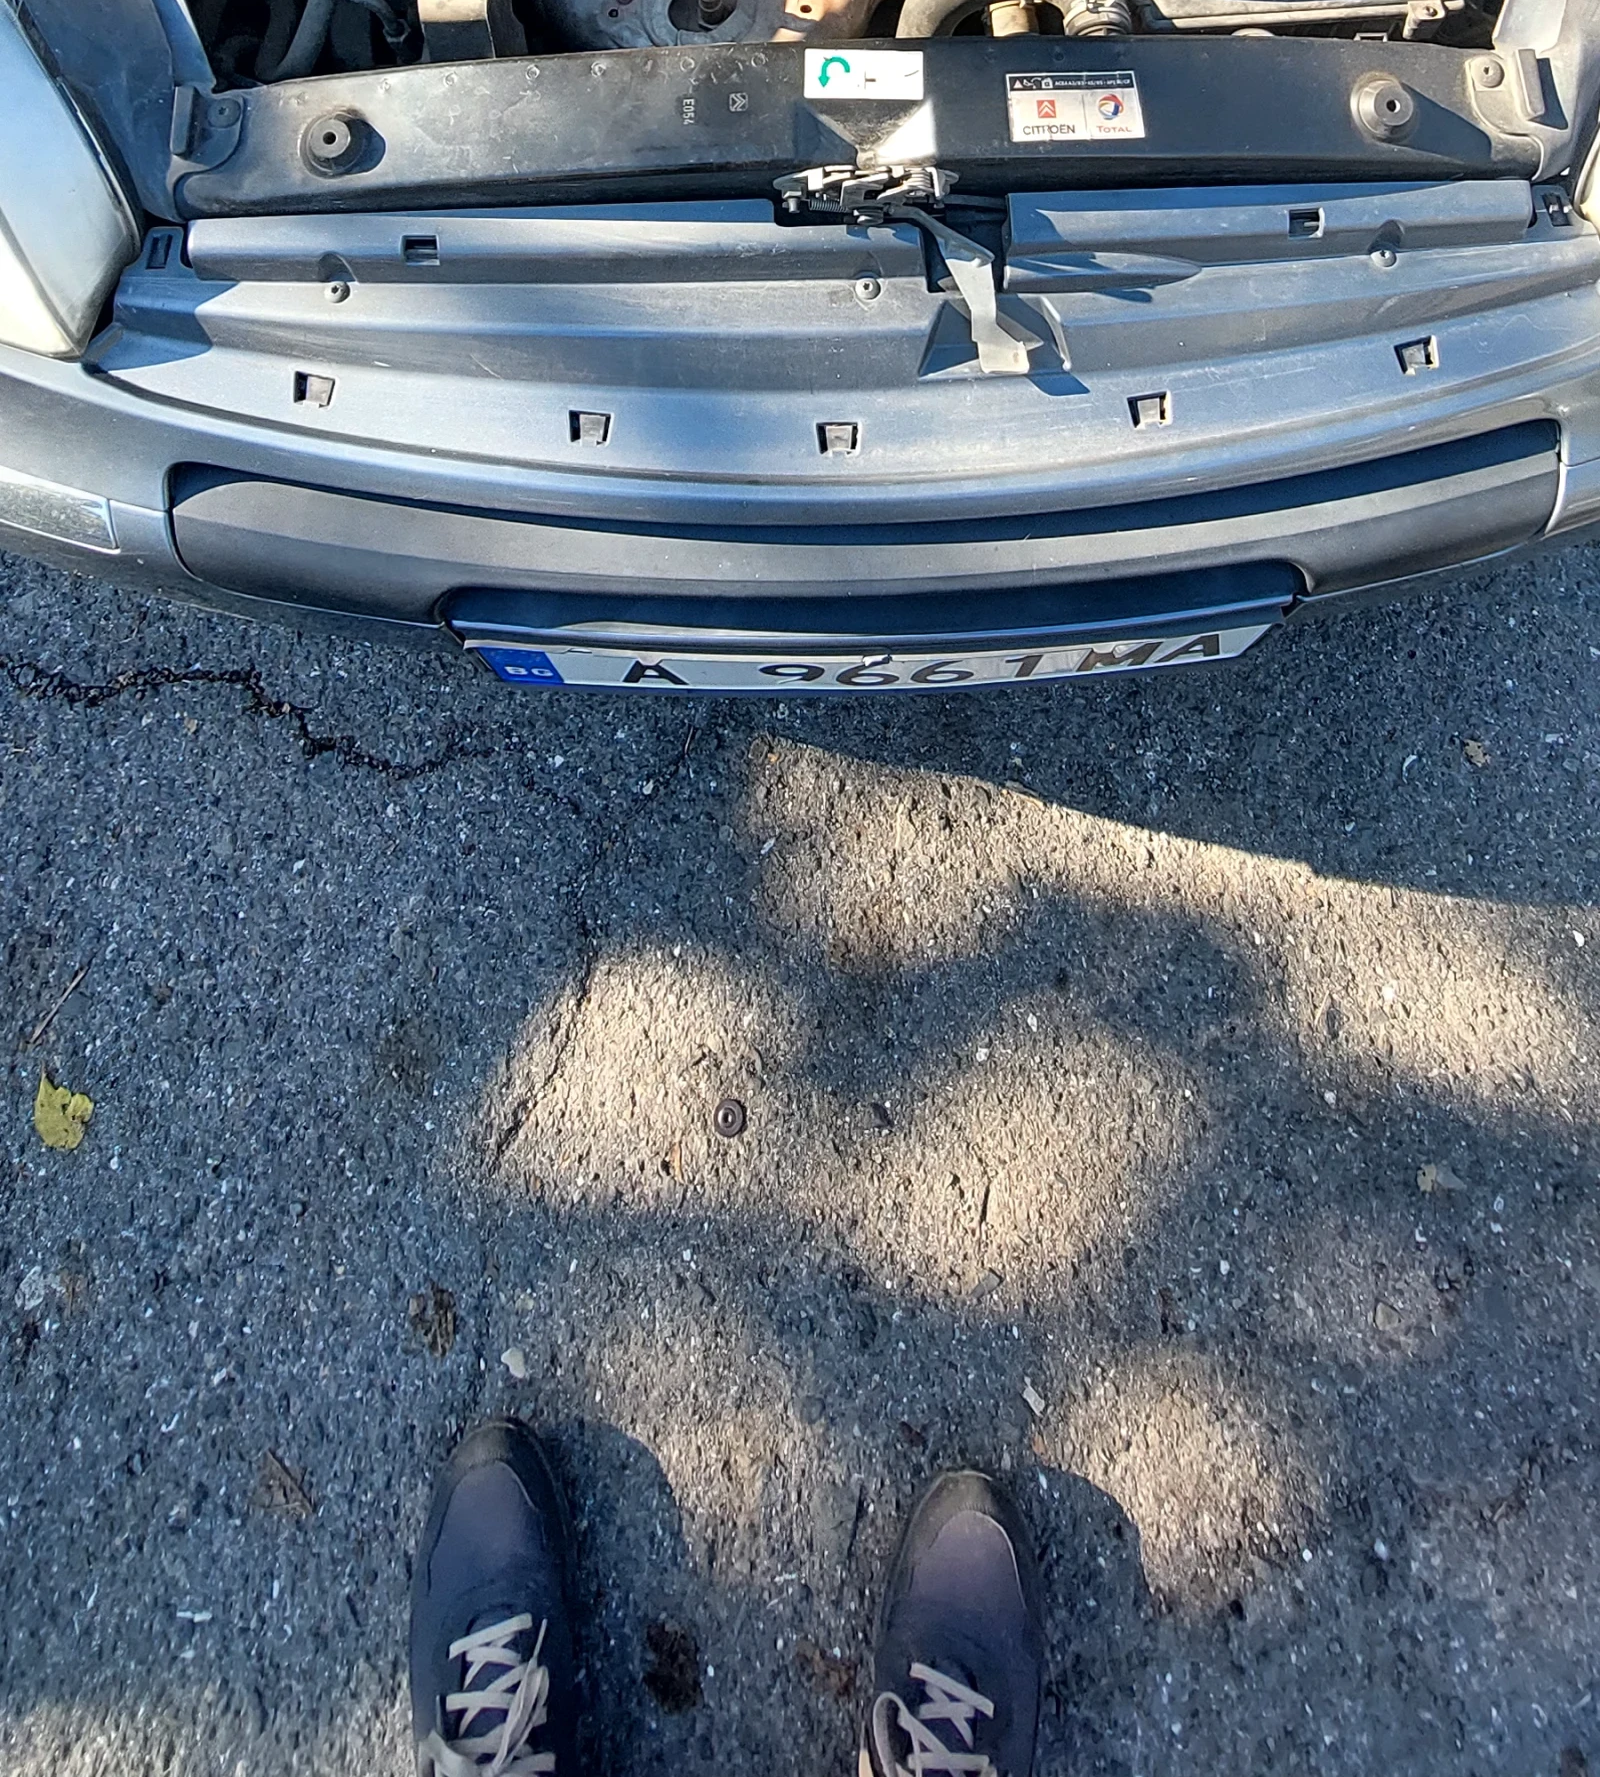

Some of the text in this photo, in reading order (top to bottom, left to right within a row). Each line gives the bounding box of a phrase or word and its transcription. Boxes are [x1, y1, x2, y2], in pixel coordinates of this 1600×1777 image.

[1096, 125, 1132, 134] TOTAL
[622, 633, 1220, 687] A 9661 MA
[503, 665, 555, 678] BG
